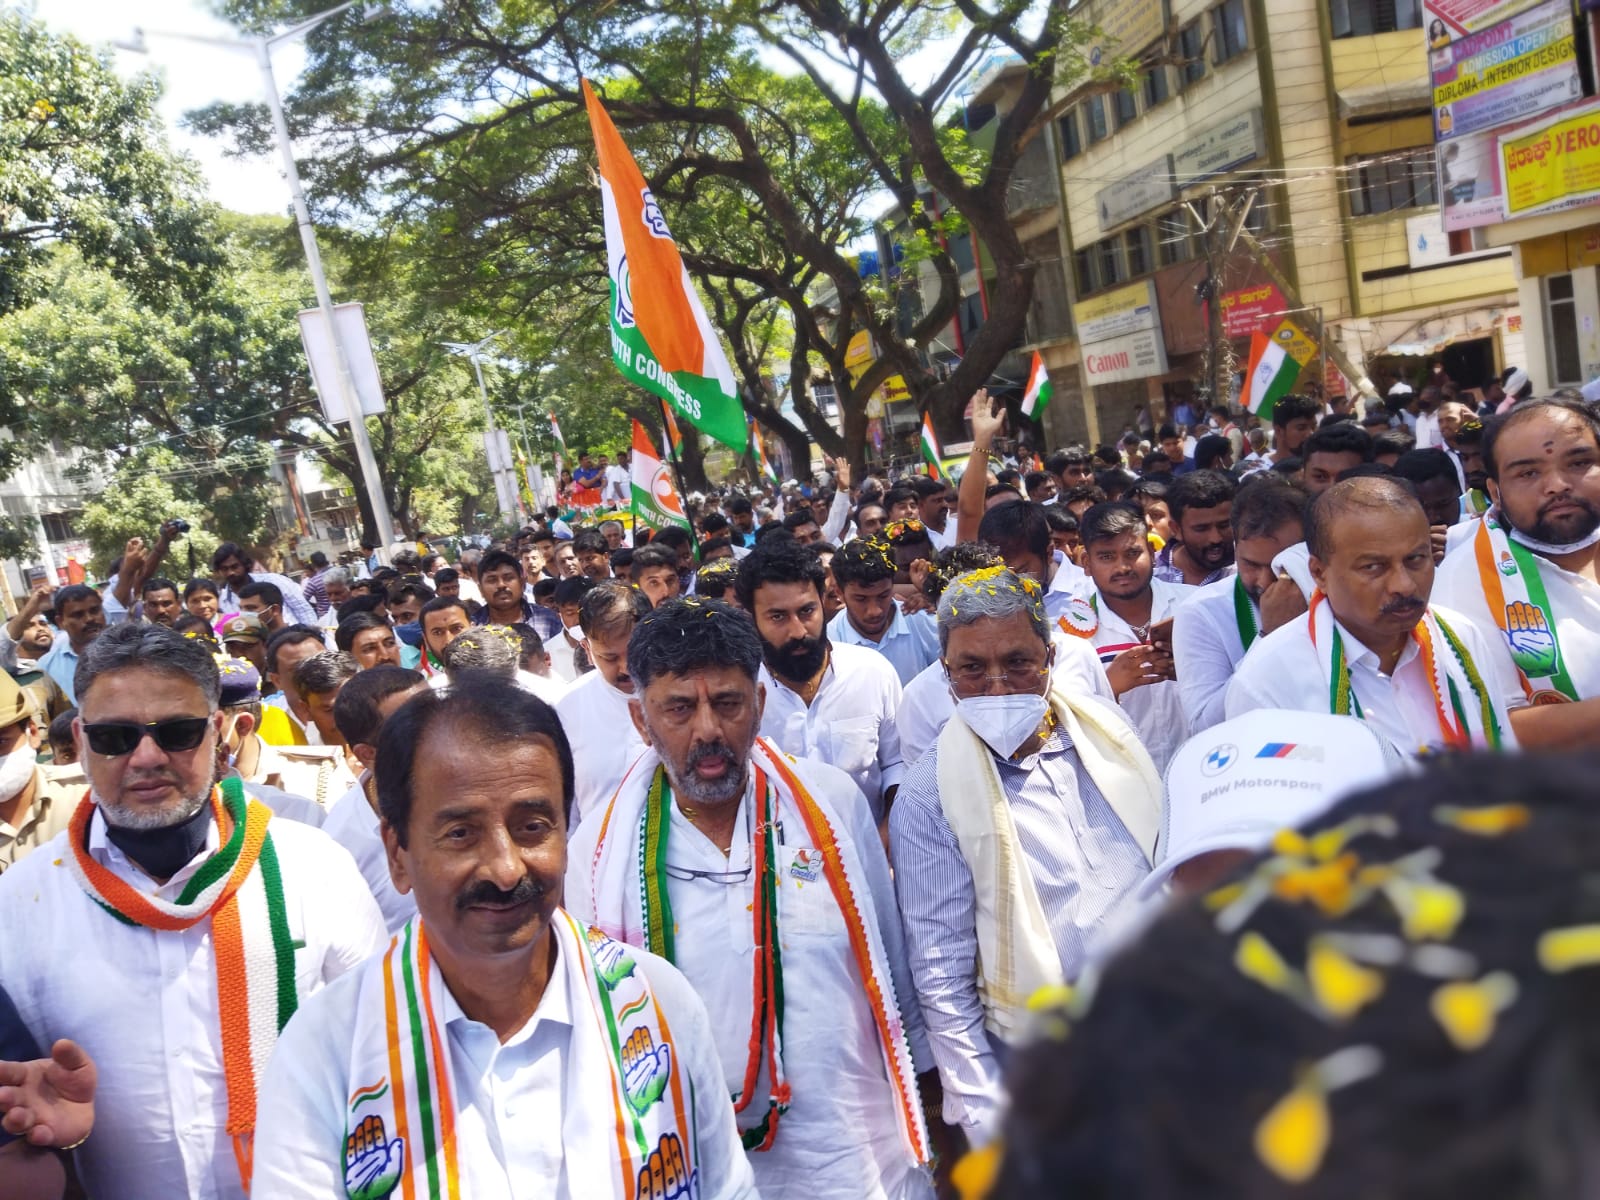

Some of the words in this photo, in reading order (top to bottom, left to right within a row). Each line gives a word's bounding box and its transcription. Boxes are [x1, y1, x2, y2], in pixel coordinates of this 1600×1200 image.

[1438, 78, 1479, 103] DIPLOMA
[1486, 60, 1531, 87] INTERIOR
[1533, 41, 1577, 68] DESIGN
[1463, 43, 1516, 75] ADMISSION
[1517, 34, 1546, 53] OPEN
[1547, 20, 1574, 43] FOR
[636, 353, 702, 420] CONGRESS
[1087, 351, 1130, 375] Canon
[1200, 782, 1231, 805] BMW
[1233, 777, 1323, 793] Motorsport
